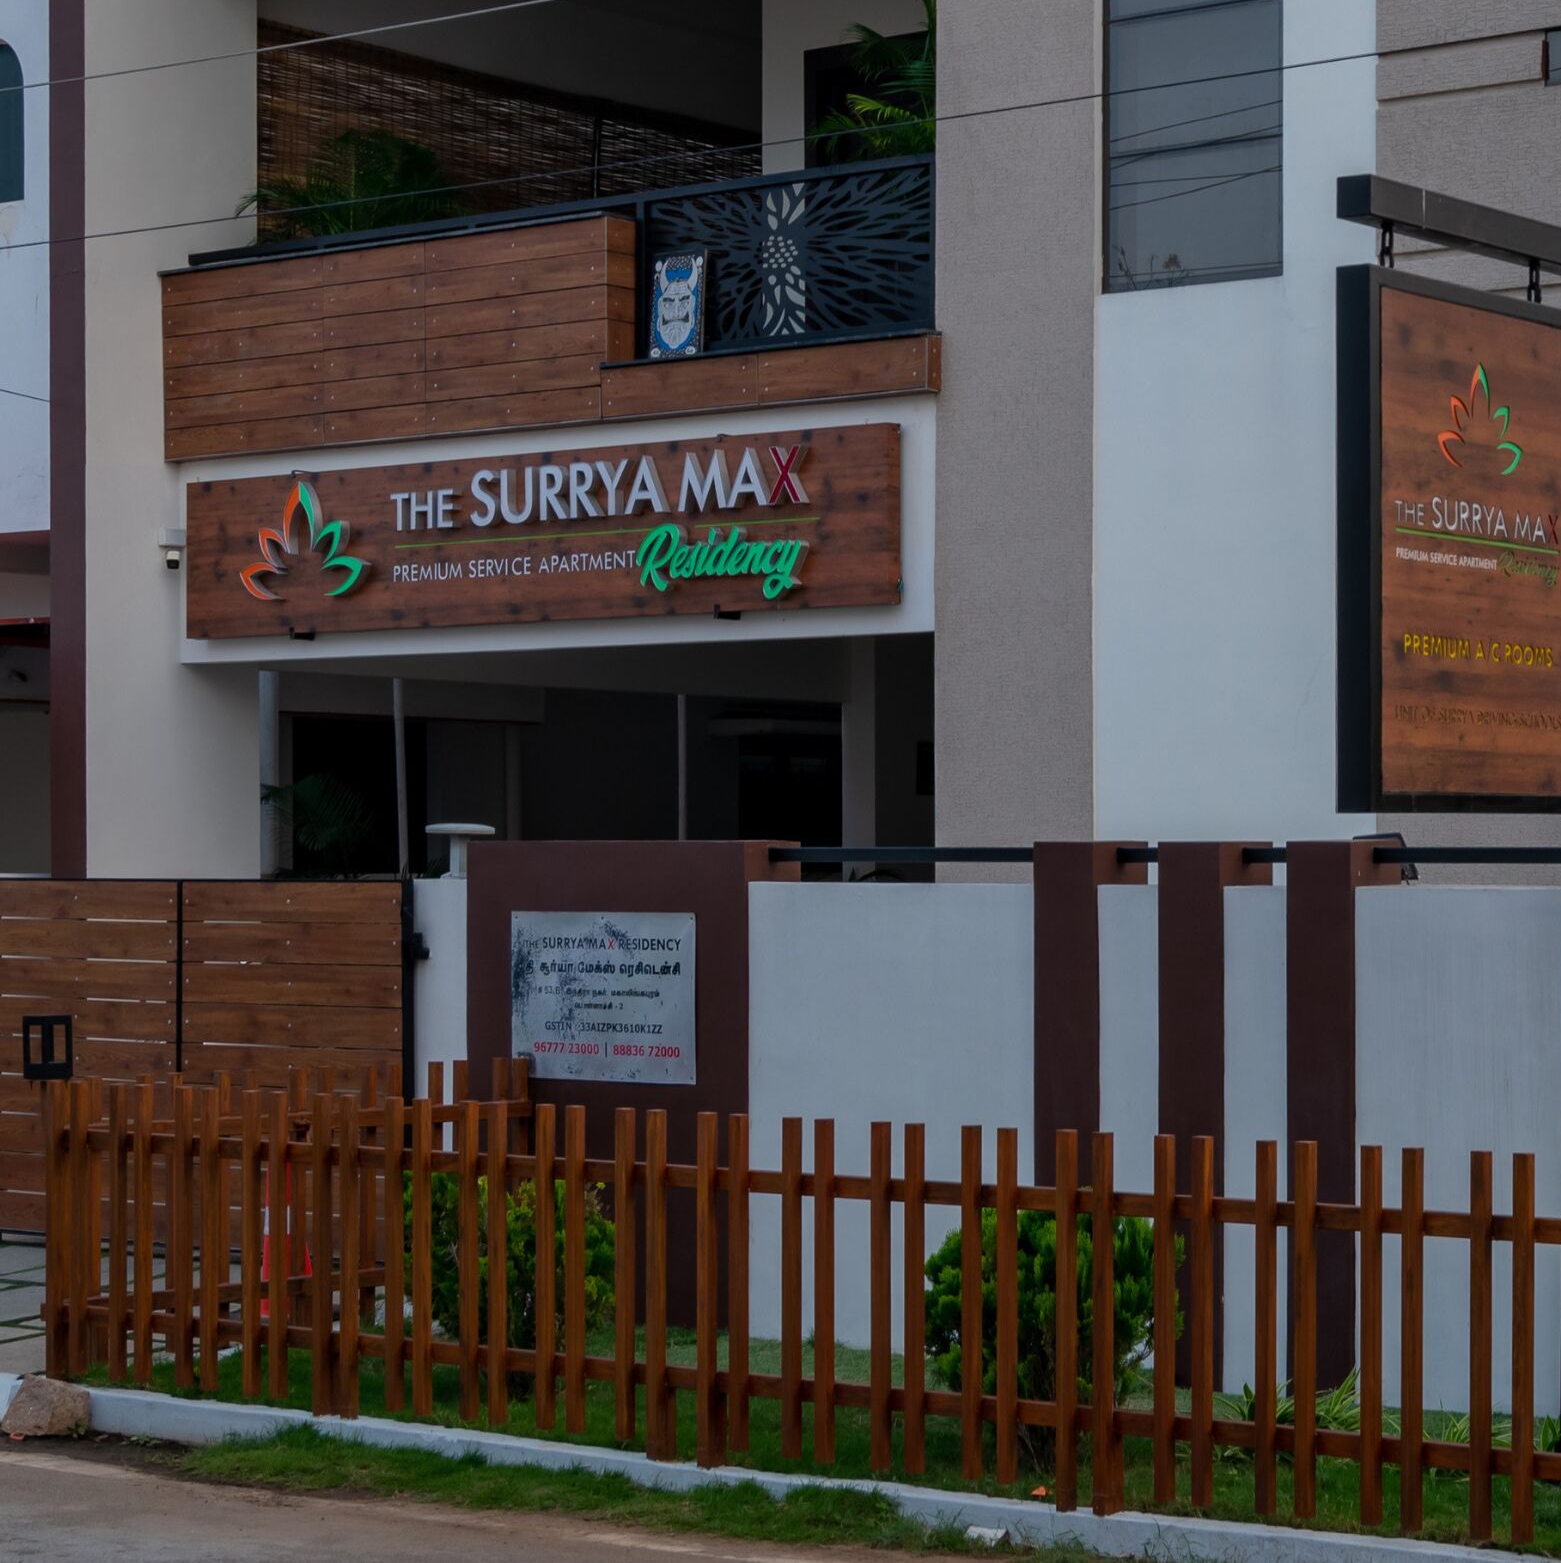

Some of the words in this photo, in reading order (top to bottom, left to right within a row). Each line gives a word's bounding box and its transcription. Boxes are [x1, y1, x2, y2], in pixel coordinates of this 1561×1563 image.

[390, 488, 460, 532] THE
[469, 454, 669, 528] SURRYA
[678, 444, 808, 512] MAX
[1394, 500, 1425, 526] THE
[1432, 496, 1509, 538] SURRYA
[1514, 511, 1560, 546] MAX
[392, 562, 463, 583] PREMIUM
[468, 556, 532, 576] SERVICE
[538, 549, 636, 574] APARTMENT
[636, 522, 803, 600] Residency
[1395, 546, 1429, 563] PREMIUM
[1430, 552, 1457, 567] SERVICE
[1458, 556, 1498, 571] APARTMENT
[1404, 633, 1471, 661] PREMIUM
[1504, 644, 1553, 668] ROOMS
[525, 939, 539, 949] THE
[542, 937, 585, 950] SURRYA
[588, 938, 615, 950] MAX
[618, 938, 682, 951] RESIDENCY
[578, 960, 615, 975] மேக்ஸ்
[619, 960, 681, 978] ரெசிடென்சி
[545, 1020, 572, 1031] GSTIN
[534, 1041, 565, 1053] 96777
[568, 1042, 599, 1055] 23000
[613, 1044, 645, 1056] 88836
[647, 1045, 681, 1058] 72000
